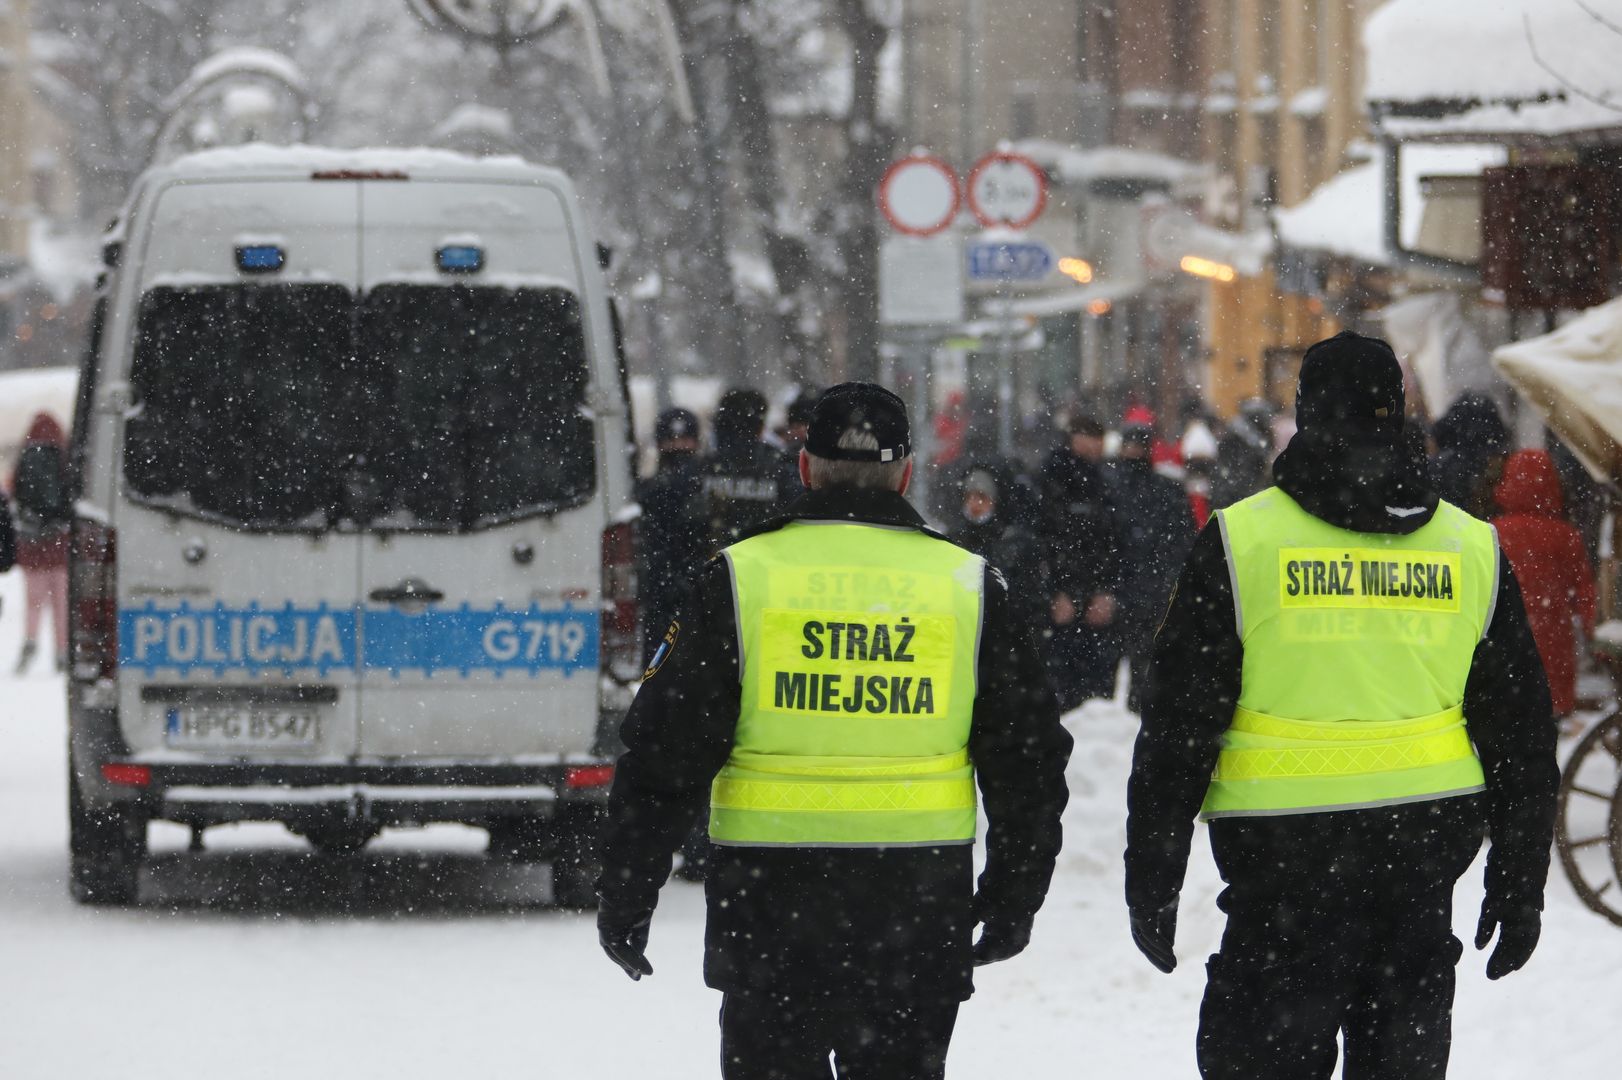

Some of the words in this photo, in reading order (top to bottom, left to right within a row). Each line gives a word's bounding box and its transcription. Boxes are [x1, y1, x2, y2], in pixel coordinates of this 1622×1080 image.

[1286, 554, 1354, 596] STRAŻ
[1361, 561, 1453, 599] MIEJSKA
[134, 616, 343, 661] POLICJA
[483, 619, 585, 661] G719
[801, 617, 915, 662] STRAŻ
[774, 671, 934, 714] MIEJSKA
